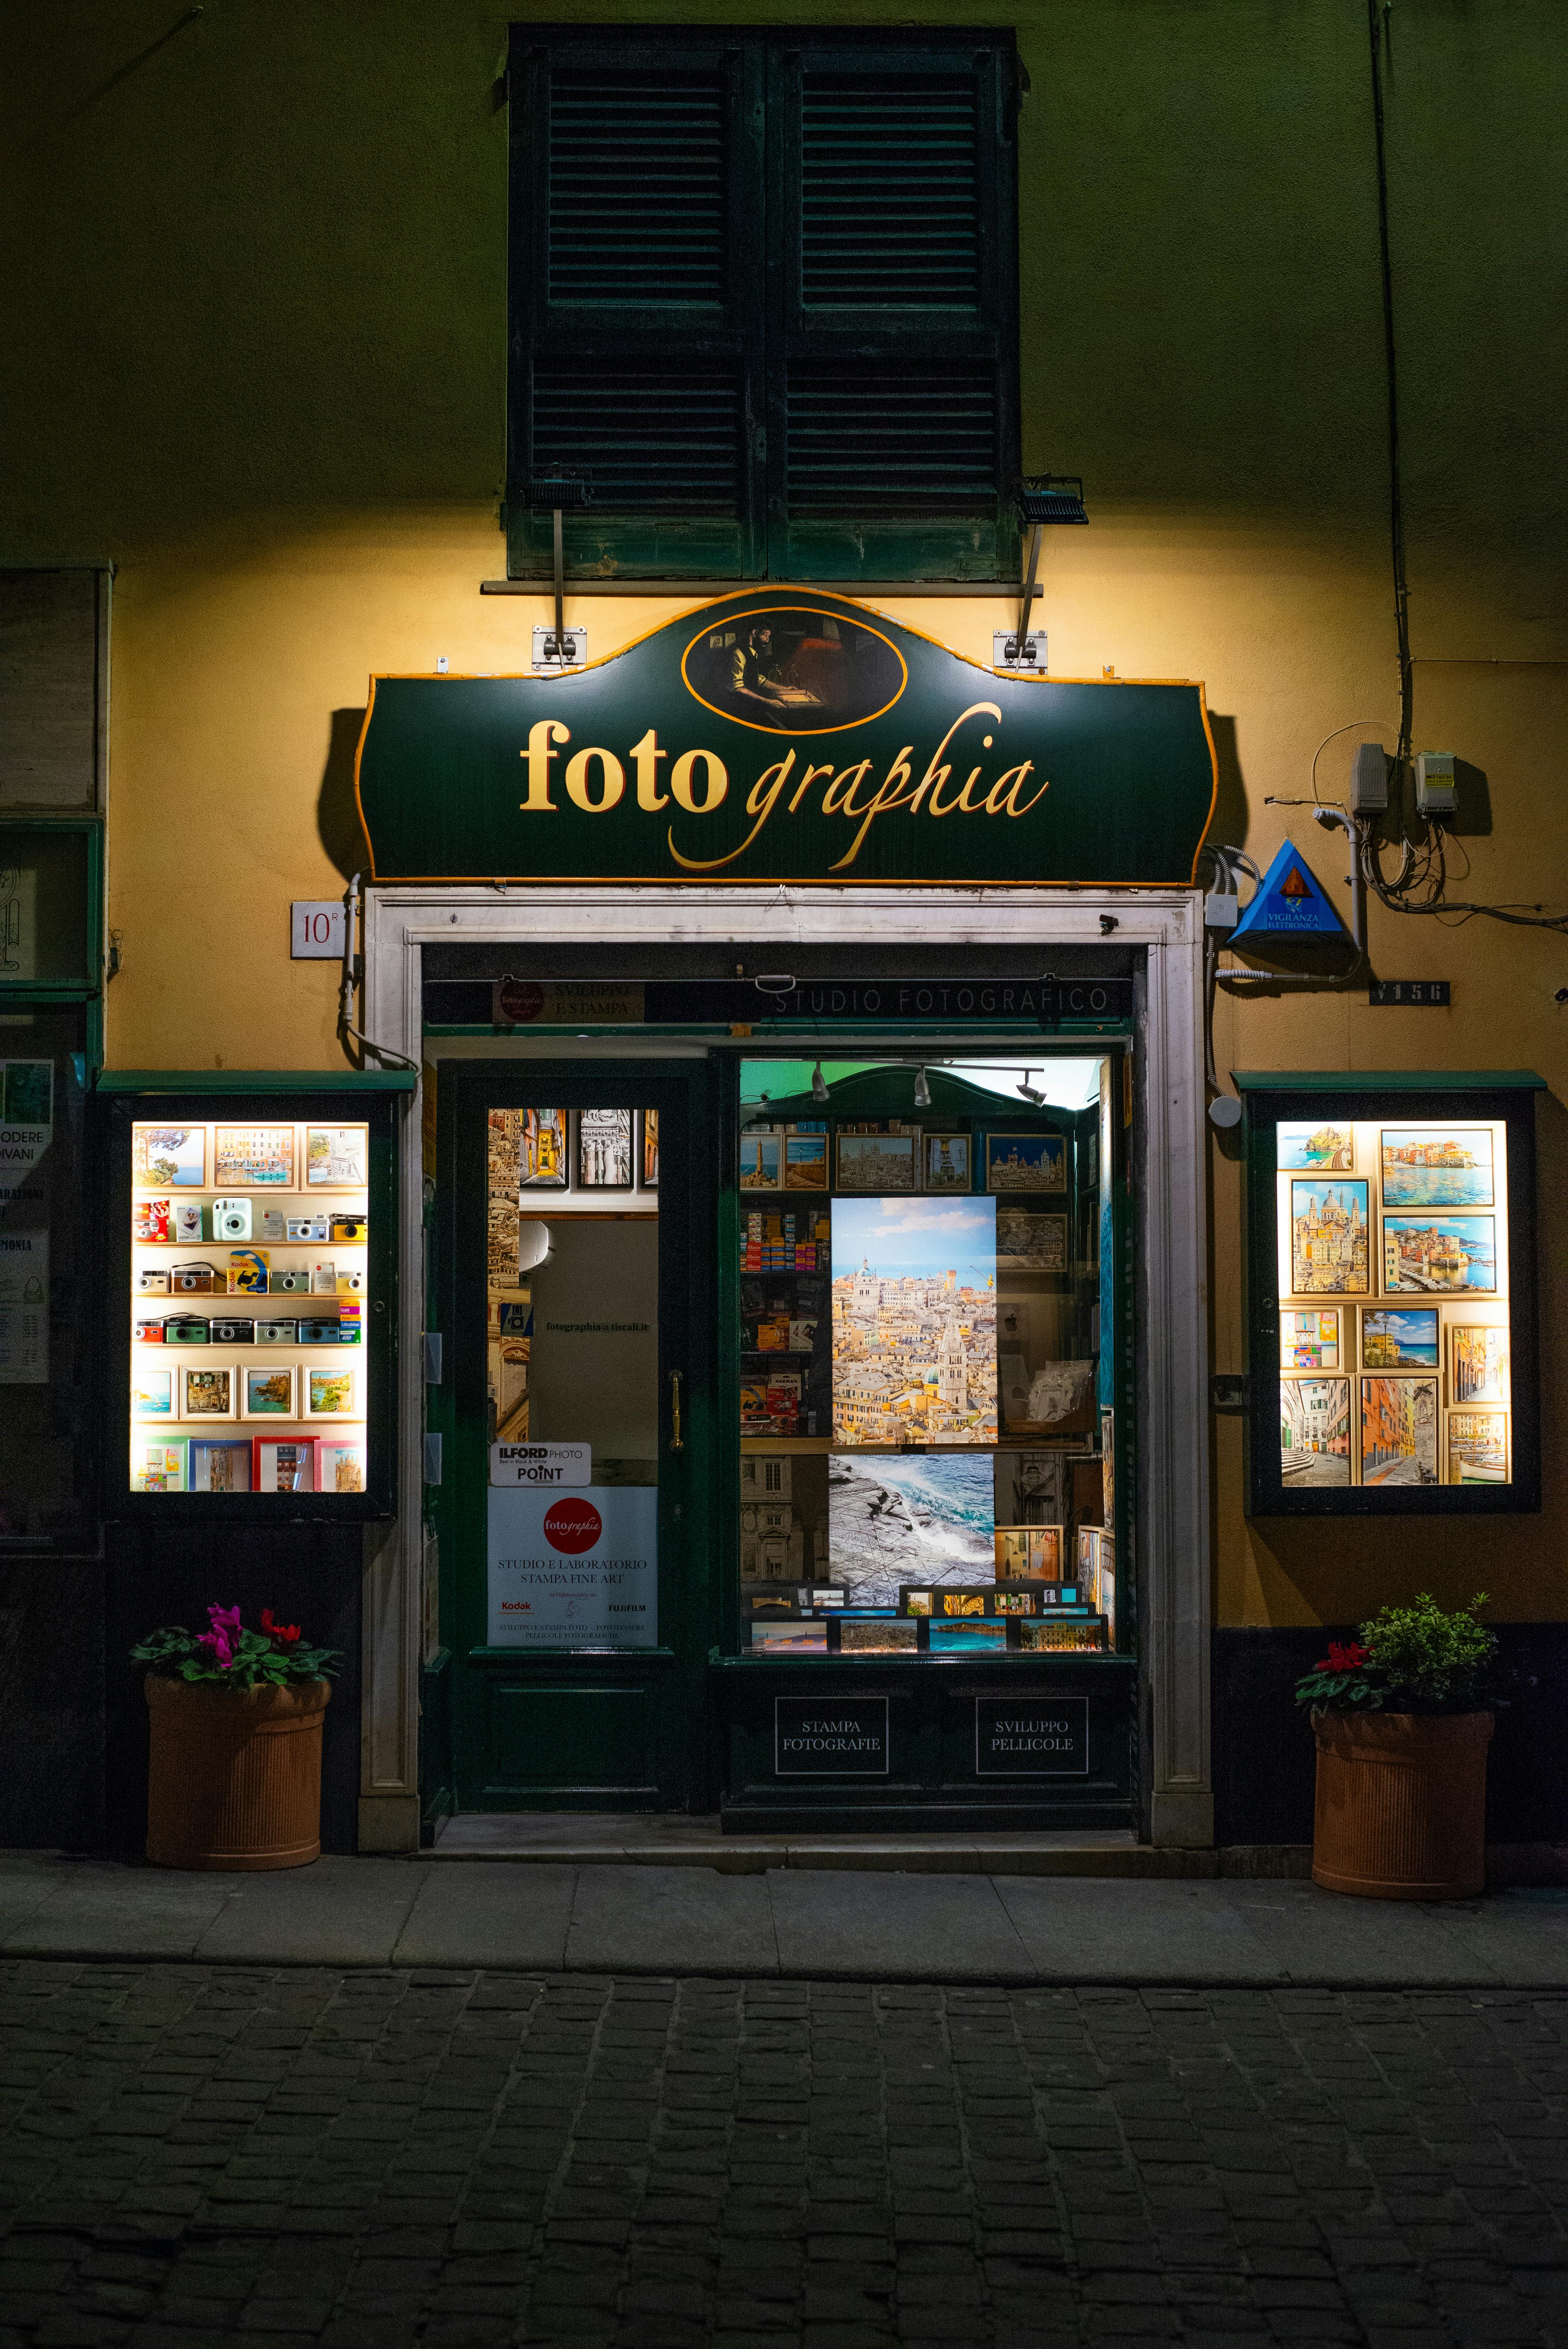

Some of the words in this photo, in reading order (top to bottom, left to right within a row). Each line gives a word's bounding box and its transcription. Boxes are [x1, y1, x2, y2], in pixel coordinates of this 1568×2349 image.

[1269, 913, 1319, 921] VIGILANZA
[556, 984, 629, 996] SVILUPPO
[775, 988, 881, 1012] STUDIO
[900, 987, 1107, 1012] FOTOGRAFICO
[556, 1004, 565, 1014] E
[568, 1003, 629, 1014] STAMPA
[0, 1149, 34, 1159] IVANI
[547, 1322, 648, 1333] fotographia@tiscali.it
[499, 1447, 548, 1458] ILFORD
[550, 1450, 583, 1459] PHOTO
[498, 1560, 545, 1569] STUDIO
[549, 1560, 556, 1569] E
[559, 1560, 647, 1569] LABORATORIO
[521, 1574, 567, 1584] STAMPA
[571, 1574, 597, 1584] FINE
[600, 1574, 625, 1584] ART
[502, 1602, 531, 1610] Kodak
[802, 1720, 861, 1732] STAMPA
[996, 1720, 1069, 1733] SVILUPPO
[783, 1738, 881, 1751] FOTOGRAFIE
[991, 1738, 1074, 1751] PELLICOLE
